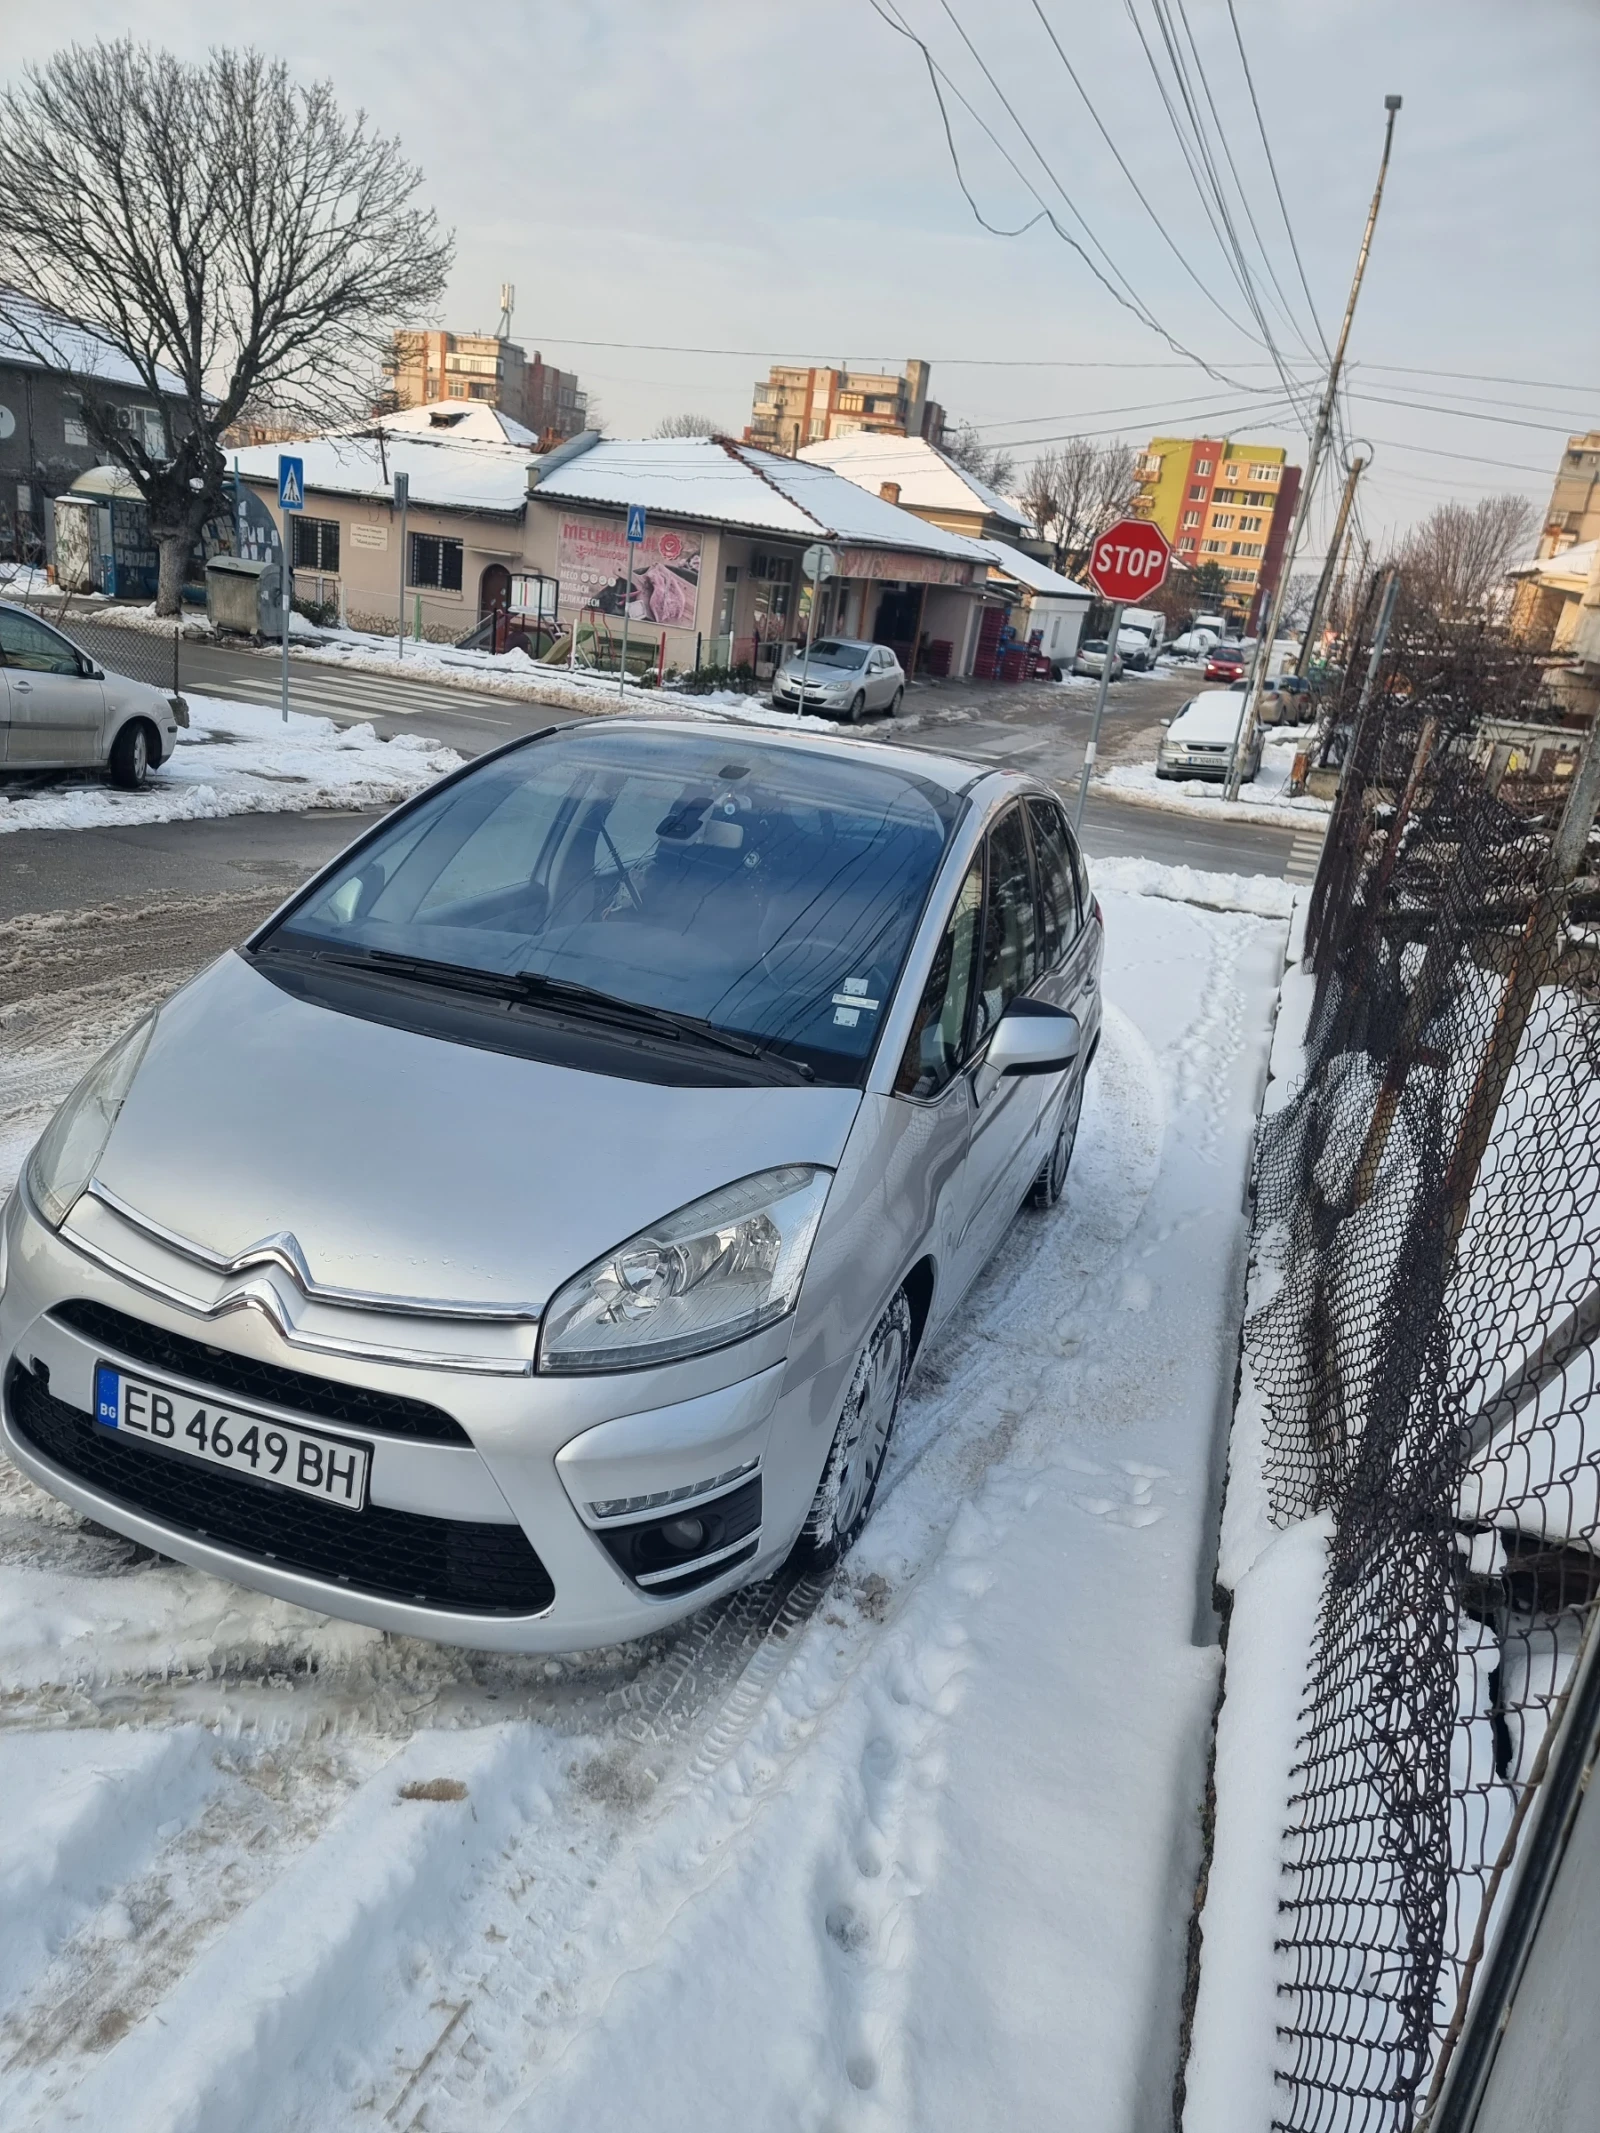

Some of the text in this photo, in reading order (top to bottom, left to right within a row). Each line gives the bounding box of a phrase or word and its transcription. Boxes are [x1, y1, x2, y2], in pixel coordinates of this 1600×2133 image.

[1096, 543, 1163, 578] STOP
[560, 570, 578, 580] МЕСО
[560, 581, 590, 594] КОЛБАСИ
[559, 593, 600, 607] ДЕЛИКАТЕСИ
[100, 1402, 117, 1419] BG
[124, 1384, 356, 1499] EB 4649 BH
